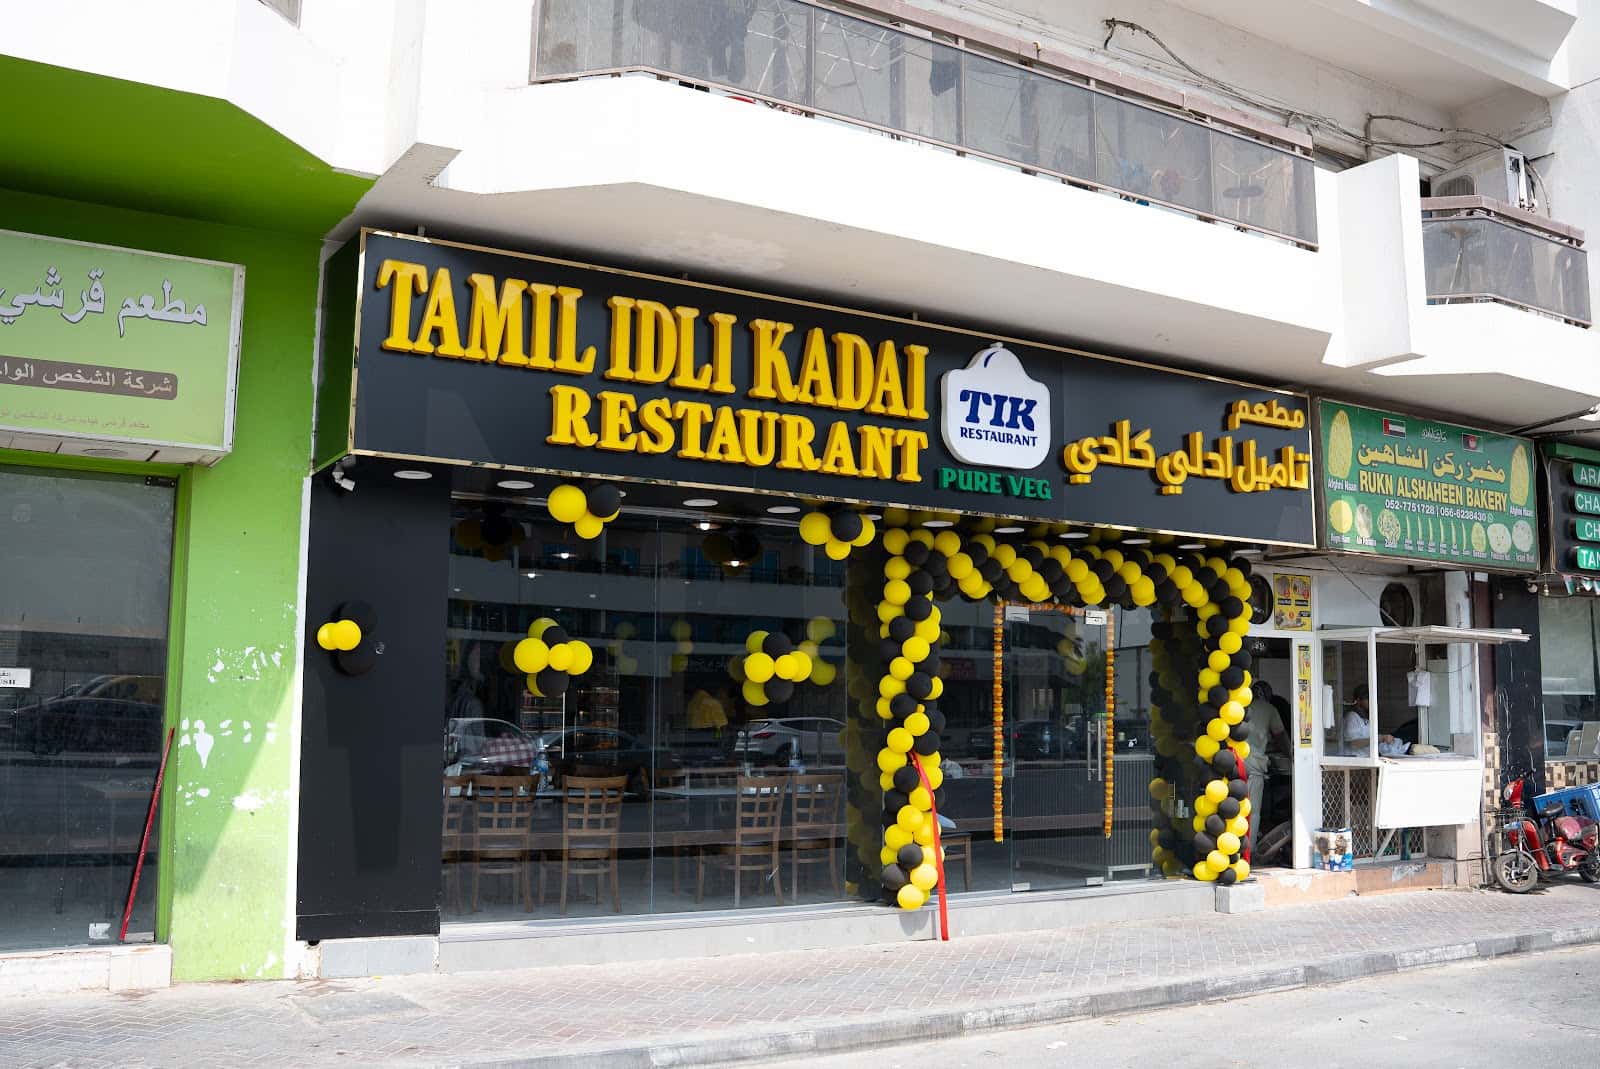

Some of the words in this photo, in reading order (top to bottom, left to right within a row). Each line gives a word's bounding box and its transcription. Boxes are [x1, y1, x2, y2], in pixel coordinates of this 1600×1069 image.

[117, 279, 208, 338] مطعم
[376, 259, 597, 375] TAMIL
[604, 296, 738, 393] IDLI
[748, 319, 929, 420] KADAI
[43, 368, 116, 387] الشخص
[123, 371, 173, 394] شركة
[960, 390, 1037, 431] TIK
[1228, 400, 1305, 431] مطعم
[546, 384, 929, 482] RESTAURANT
[960, 427, 1038, 447] RESTAURANT
[1064, 419, 1156, 484] كادي
[1231, 439, 1310, 493] تاميل
[1357, 443, 1429, 472] الشاهين
[1432, 452, 1464, 480] ركن
[939, 467, 1002, 494] PURE
[1006, 475, 1052, 500] VEG
[1466, 459, 1506, 484] مخبز
[1359, 470, 1394, 496] RUKN
[1397, 476, 1464, 505] ALSHAHEEN
[1466, 486, 1508, 512] BAKERY
